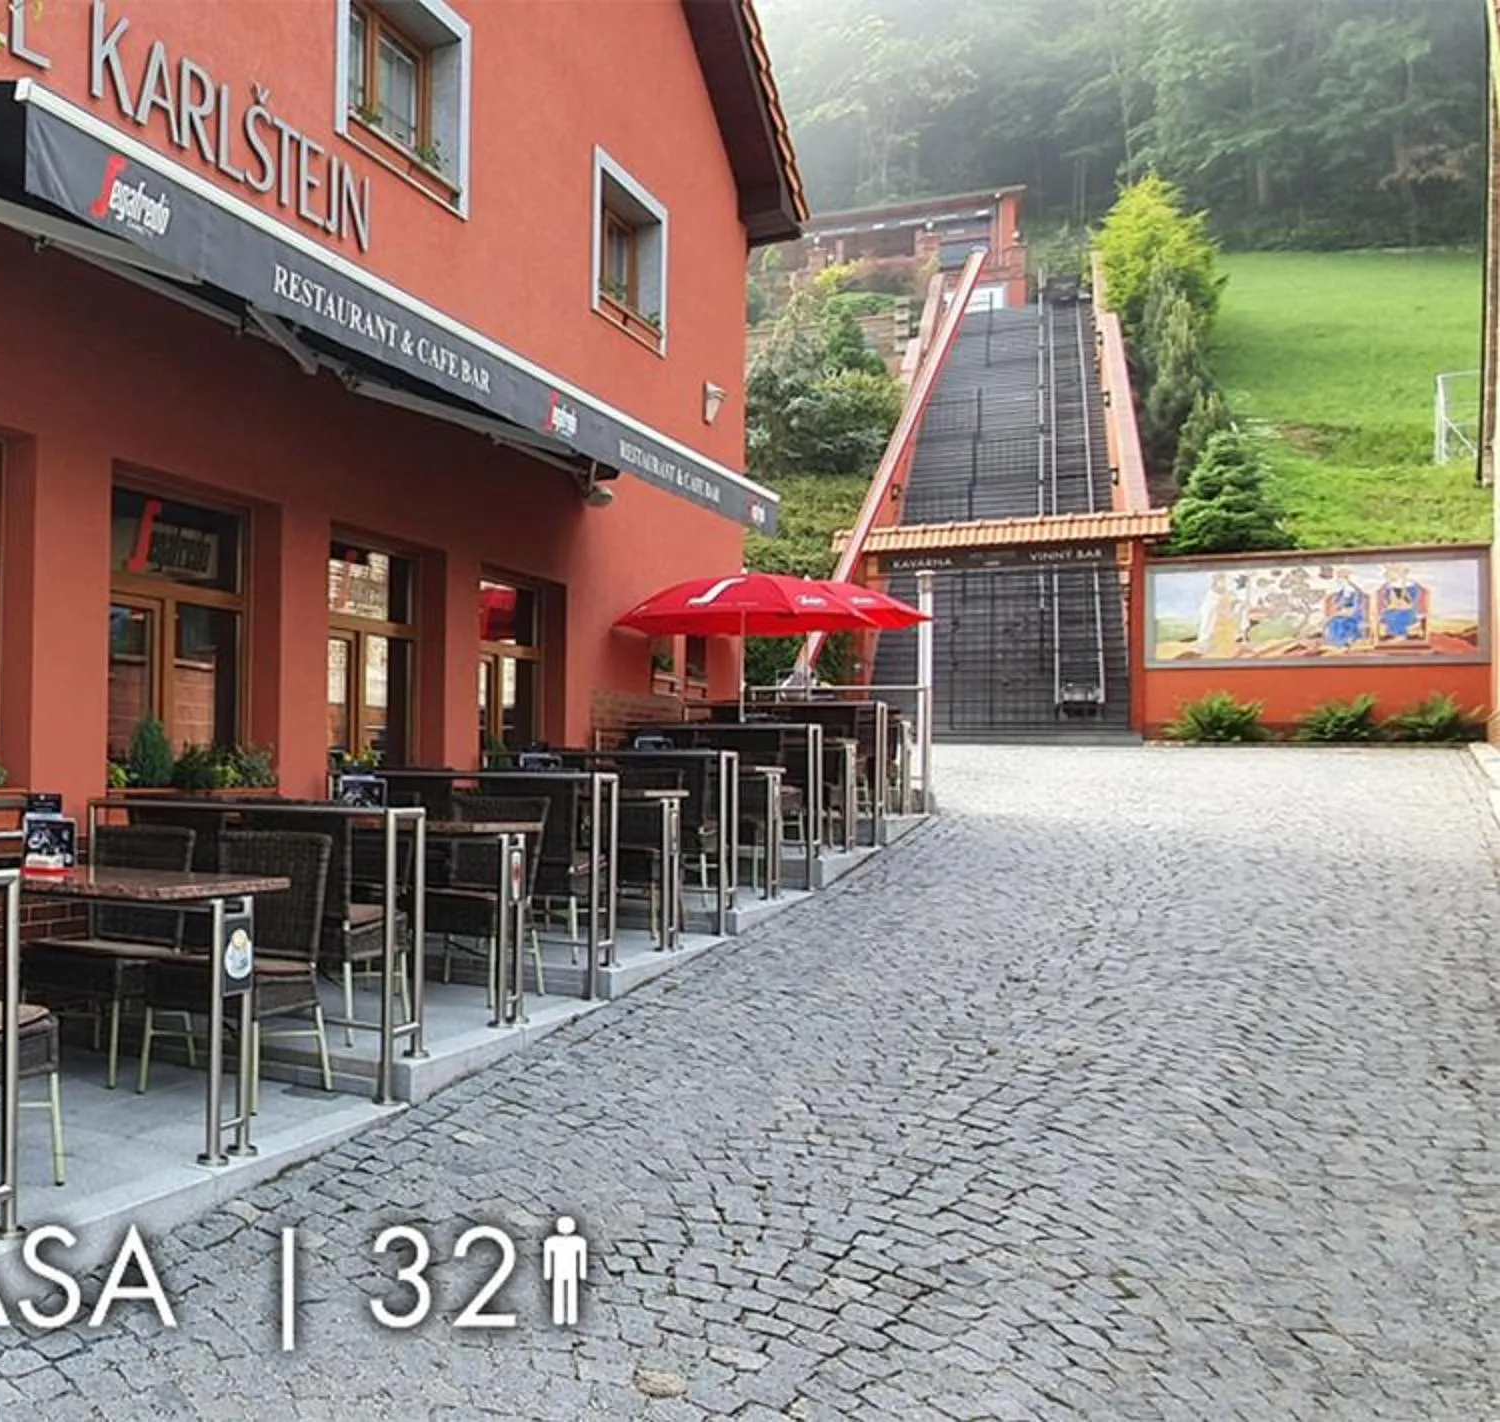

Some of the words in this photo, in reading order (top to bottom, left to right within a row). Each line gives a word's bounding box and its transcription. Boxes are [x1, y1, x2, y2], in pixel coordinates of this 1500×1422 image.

[92, 0, 371, 253] KARLŠTEJN
[91, 154, 170, 234] Segafredo
[274, 264, 398, 348] RESTAURANT
[400, 329, 414, 356] &
[417, 337, 458, 378] CAFE
[461, 355, 490, 393] BAR
